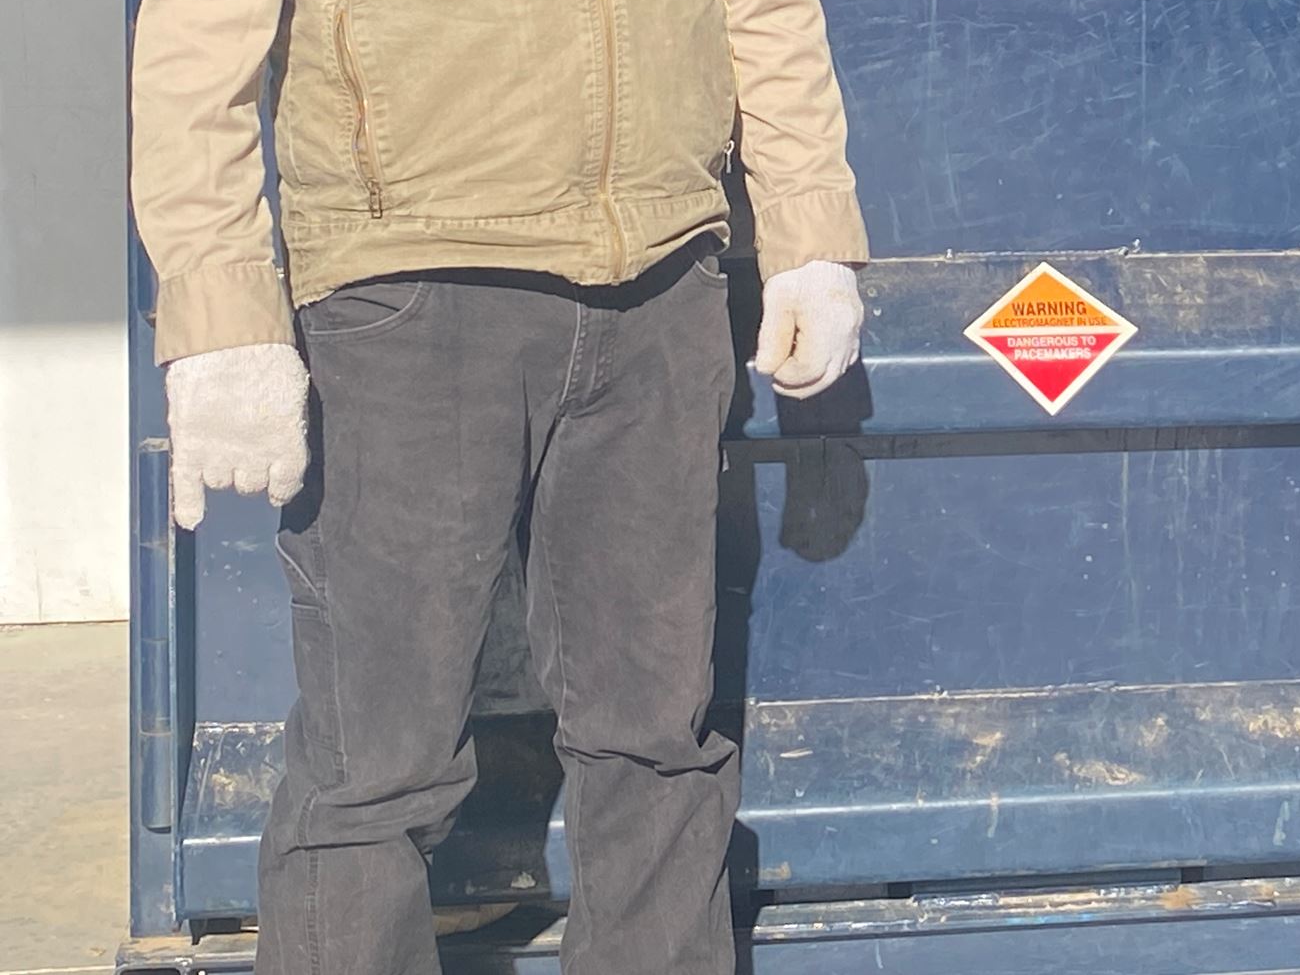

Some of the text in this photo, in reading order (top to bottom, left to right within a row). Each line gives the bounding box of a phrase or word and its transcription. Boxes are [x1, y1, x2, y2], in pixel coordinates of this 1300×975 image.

[1011, 301, 1087, 316] WARNING
[992, 315, 1108, 328] ELECTROMAGNET IN USE
[1007, 335, 1097, 347] DANGEROUS TO
[1014, 347, 1092, 360] PACEMAKERS
